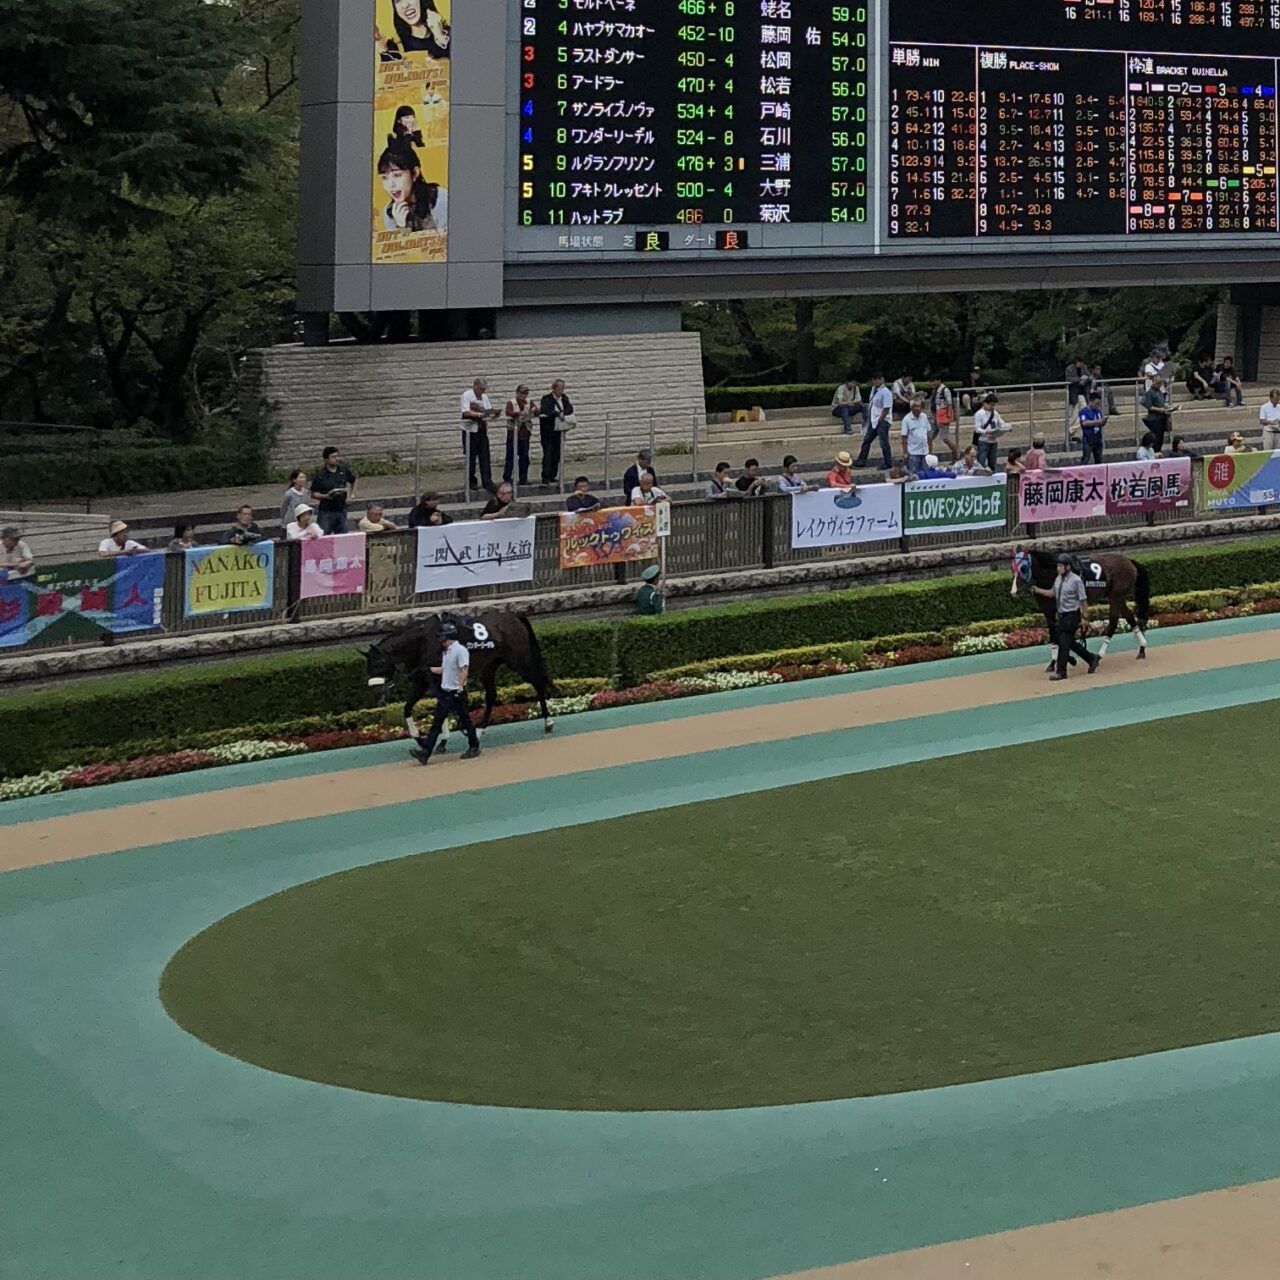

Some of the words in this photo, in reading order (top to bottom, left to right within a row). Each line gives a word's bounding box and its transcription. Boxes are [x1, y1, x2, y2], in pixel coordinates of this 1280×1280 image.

[833, 7, 865, 22] 59.0
[524, 17, 535, 35] 2
[558, 21, 567, 35] 4
[573, 21, 655, 38] ハヤブサマカオー
[761, 25, 791, 44] 藤岡
[833, 32, 865, 47] 54.0
[525, 46, 534, 61] 3
[558, 47, 567, 62] 5
[573, 48, 644, 64] ラストダンサー
[761, 50, 790, 69] 松岡
[832, 57, 865, 71] 57.0
[524, 73, 534, 88] 3
[558, 74, 567, 89] 6
[572, 75, 624, 90] アードラー
[761, 76, 791, 94] 松若
[832, 82, 865, 96] 56.0
[523, 100, 533, 115] 4
[558, 101, 567, 115] 7
[572, 100, 654, 117] サンライズノヴァ
[761, 102, 791, 120] 戸崎
[832, 107, 865, 121] 57.0
[523, 128, 533, 142] 4
[557, 128, 566, 143] 8
[572, 127, 654, 144] ワンダーリーデル
[760, 127, 790, 145] 石川
[832, 132, 864, 147] 56.0
[524, 155, 533, 170] 5
[557, 155, 566, 170] 9
[571, 154, 654, 171] ルグランフリソン
[760, 153, 791, 171] 三浦
[832, 157, 864, 172] 57.0
[523, 182, 532, 198] 5
[550, 182, 565, 197] 10
[571, 182, 662, 197] アキトクレッセント
[760, 178, 791, 196] 大野
[831, 182, 864, 197] 57.0
[524, 210, 532, 225] 6
[549, 210, 563, 224] 11
[571, 208, 623, 224] ハットラブ
[724, 209, 732, 223] 0
[760, 204, 790, 223] 菊沢
[831, 207, 864, 222] 54.0
[646, 232, 661, 251] 良
[724, 232, 740, 249] 良
[1023, 477, 1103, 507] 藤岡康太
[1110, 473, 1181, 502] 松若風馬
[1207, 498, 1235, 507] MUTO
[1263, 492, 1274, 500] 55
[566, 523, 654, 550] ルックトゥワイス
[797, 514, 898, 538] レイクヴィラファーム
[190, 551, 270, 577] NANAKO
[1090, 563, 1102, 580] 9
[194, 580, 261, 604] FUJITA
[473, 623, 488, 640] 8
